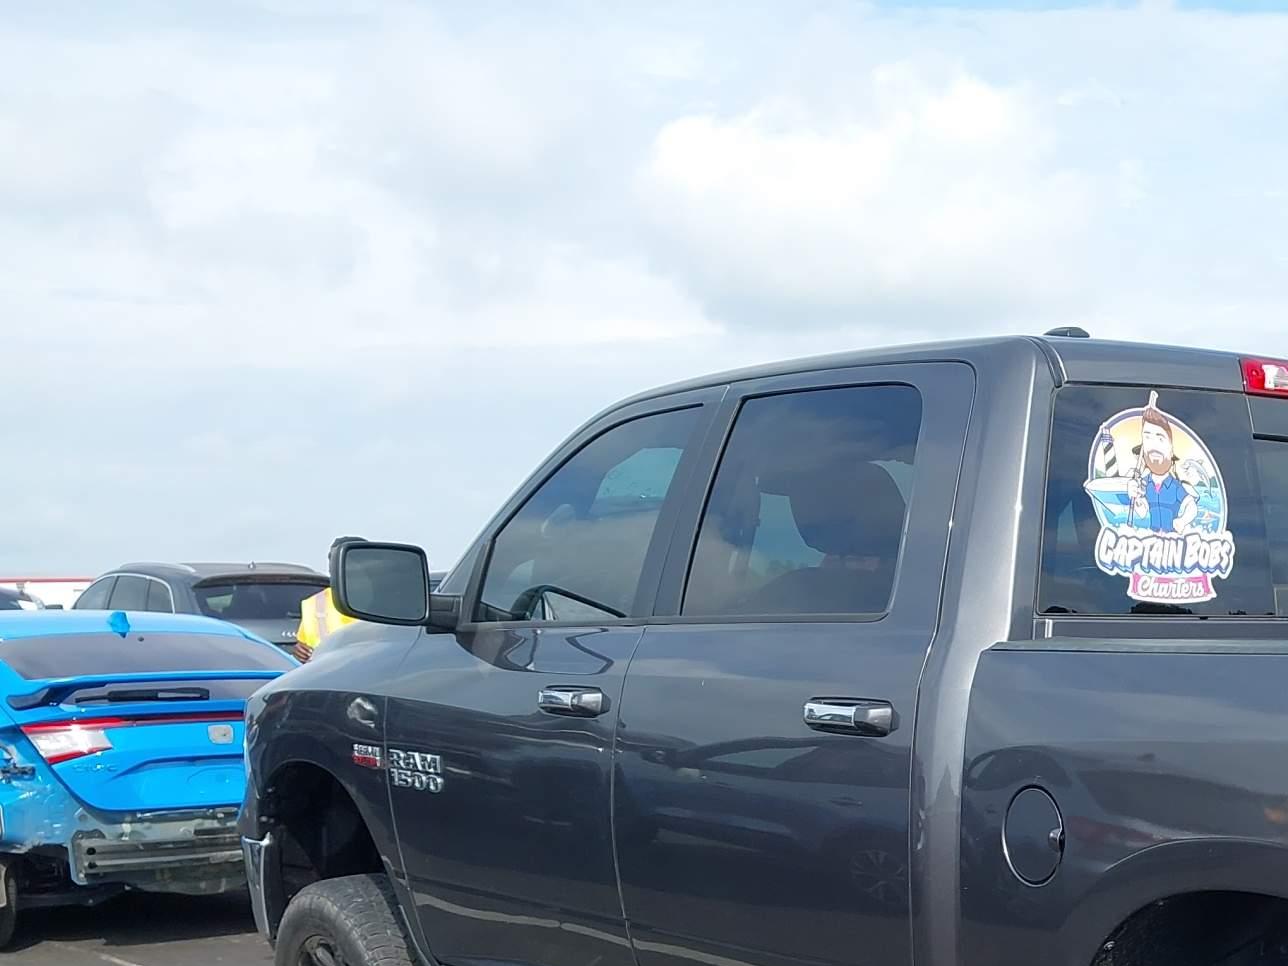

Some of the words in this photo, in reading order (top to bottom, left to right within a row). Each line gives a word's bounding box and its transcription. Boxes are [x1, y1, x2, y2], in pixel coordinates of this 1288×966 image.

[1099, 527, 1183, 574] CAPTAIN
[389, 748, 441, 773] RAM
[390, 768, 444, 793] 1500
